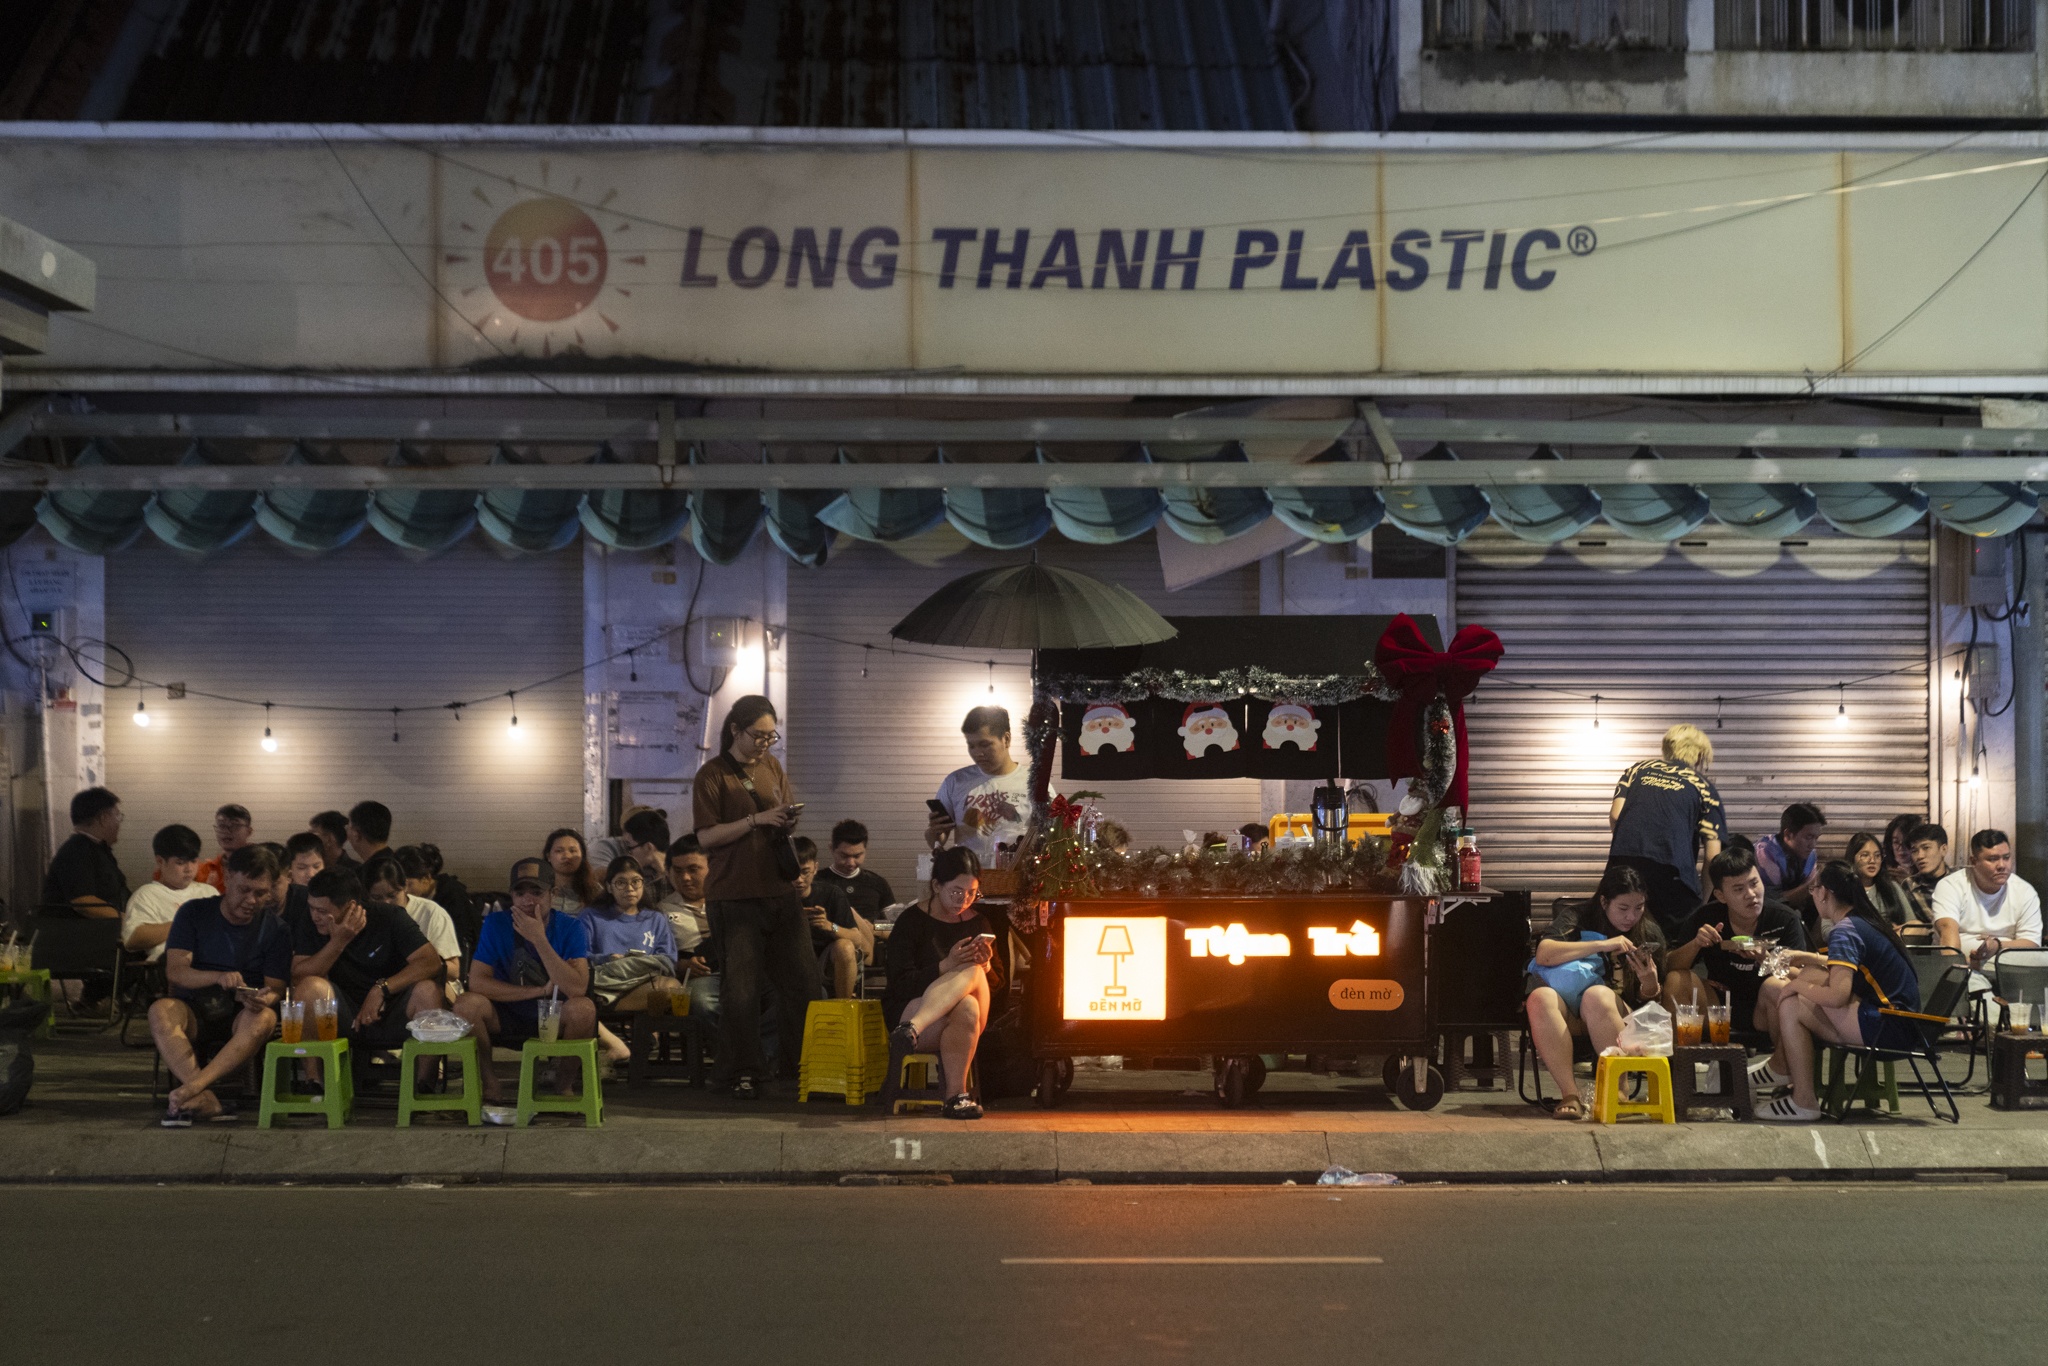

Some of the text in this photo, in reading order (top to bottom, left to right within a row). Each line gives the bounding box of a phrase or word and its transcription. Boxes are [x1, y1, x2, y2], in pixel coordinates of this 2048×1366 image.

[491, 236, 600, 284] 405
[680, 226, 900, 290] LONG
[932, 227, 1207, 291] THANH
[1185, 919, 1380, 965] Tiệm Trà
[1088, 998, 1142, 1011] ĐÈN MỜ
[1340, 987, 1392, 1000] đèn mờ
[889, 1137, 922, 1160] 11
